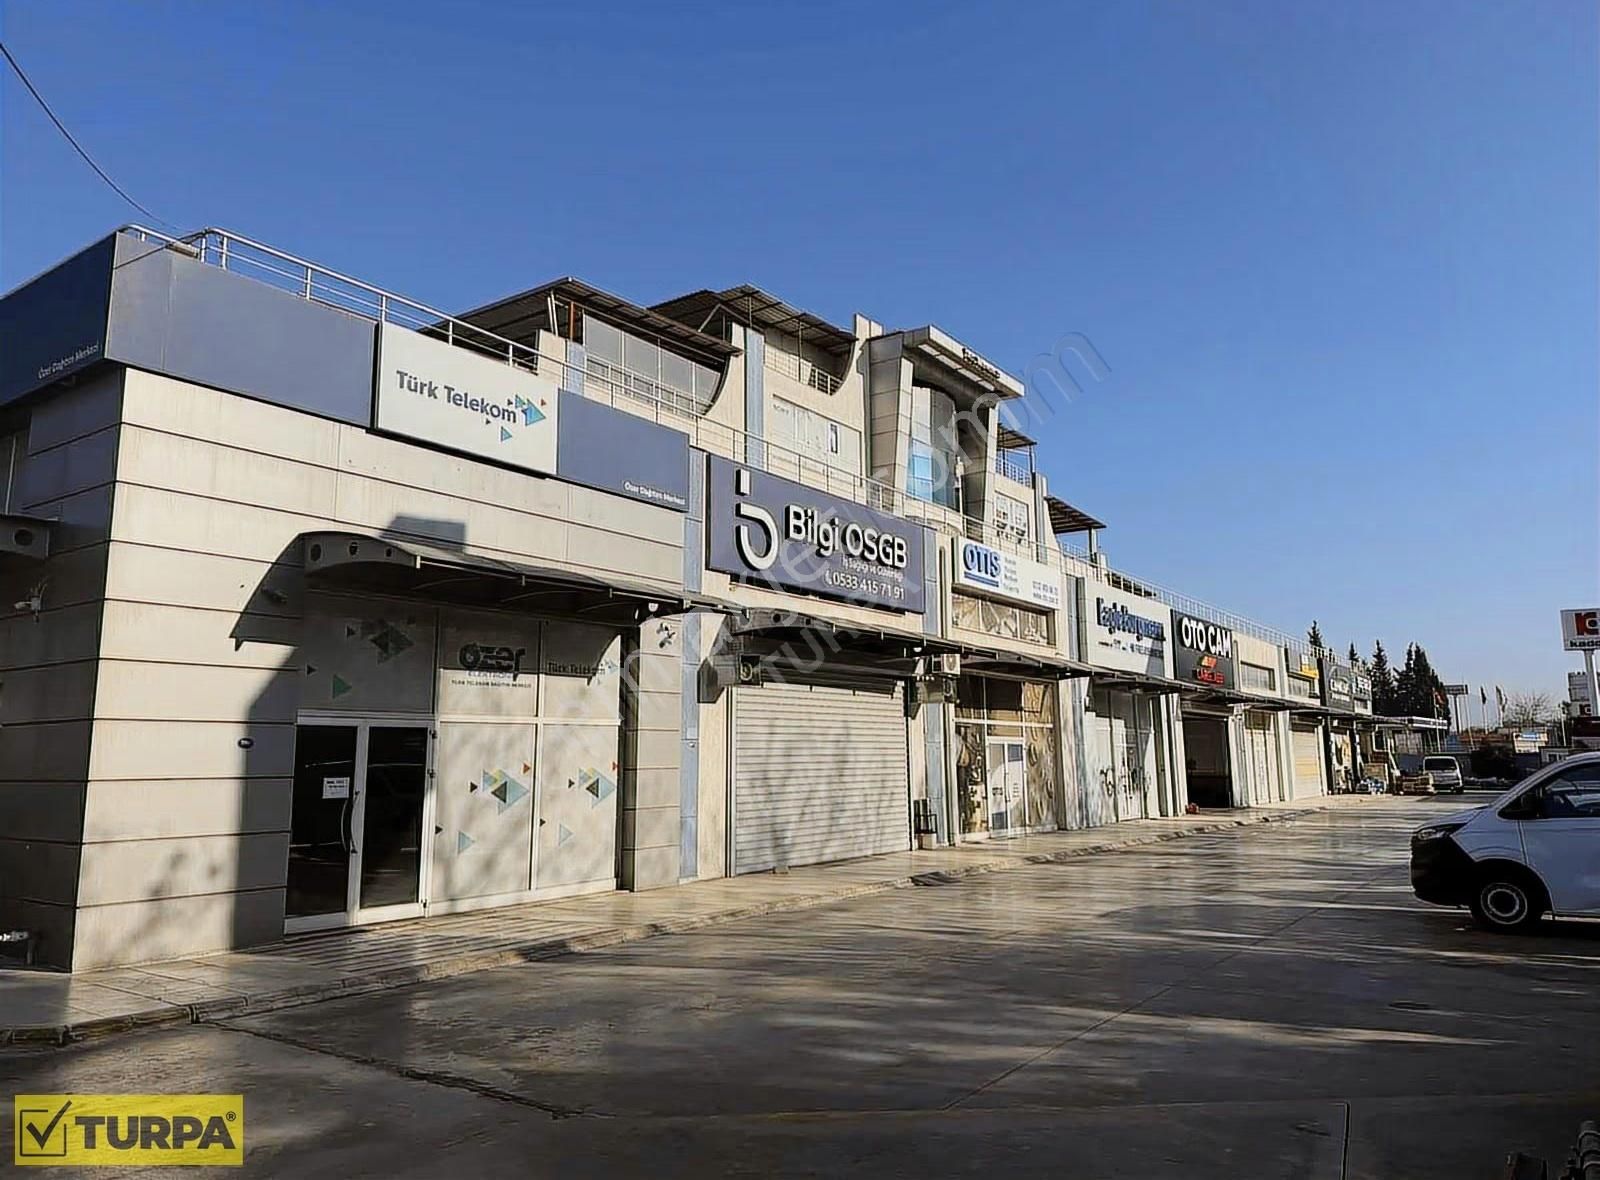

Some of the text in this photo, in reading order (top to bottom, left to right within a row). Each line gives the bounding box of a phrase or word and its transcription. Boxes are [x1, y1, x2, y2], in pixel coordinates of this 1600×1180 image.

[396, 369, 517, 424] Türk Telekom
[786, 503, 908, 569] Bilgi OSGB
[963, 543, 1001, 578] OTIS
[832, 572, 859, 590] 0533
[860, 578, 879, 594] 415
[1180, 616, 1207, 652] OTO
[1207, 624, 1232, 659] CAM
